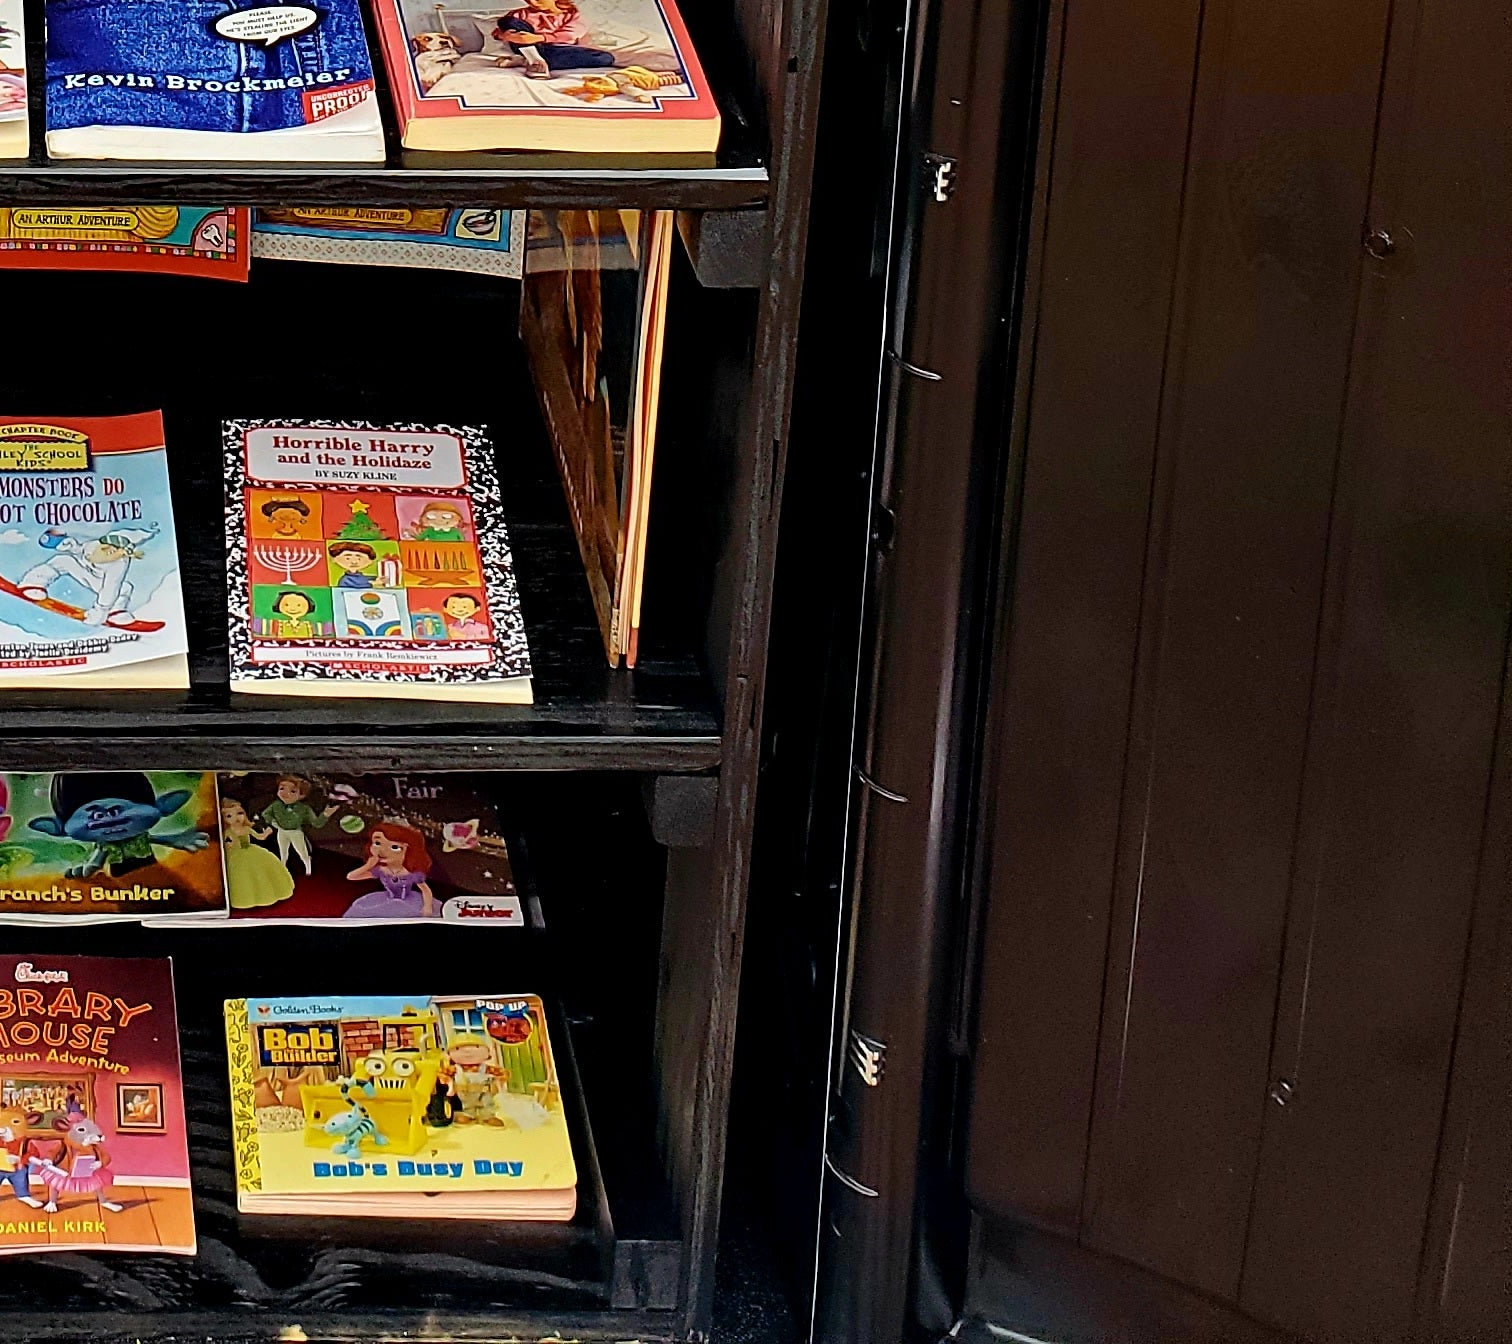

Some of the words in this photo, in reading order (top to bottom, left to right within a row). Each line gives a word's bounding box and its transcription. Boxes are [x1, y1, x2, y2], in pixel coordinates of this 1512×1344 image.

[64, 73, 155, 90] Kevin
[165, 67, 352, 94] Brockmeier
[17, 213, 33, 225] AN
[34, 213, 72, 226] ARTHUR
[76, 214, 132, 227] ADVENTURE
[32, 449, 83, 460] SCHOOL
[272, 435, 363, 452] Horrible
[368, 438, 435, 457] Harry
[276, 452, 312, 466] and
[316, 453, 347, 467] the
[351, 454, 432, 470] Holidaze
[314, 469, 330, 479] BY
[331, 470, 361, 481] SUZY
[361, 471, 398, 481] KLINE
[102, 477, 126, 497] DO
[33, 498, 143, 526] CHOCOLATE
[390, 777, 445, 801] Fair
[90, 885, 176, 903] Bunker
[262, 1026, 335, 1051] Bob
[46, 1048, 131, 1076] Adventure
[270, 1047, 338, 1064] Builder
[312, 1159, 389, 1179] Bob's
[396, 1159, 465, 1179] Busy
[472, 1158, 525, 1179] Day
[63, 1220, 108, 1234] KIRK
